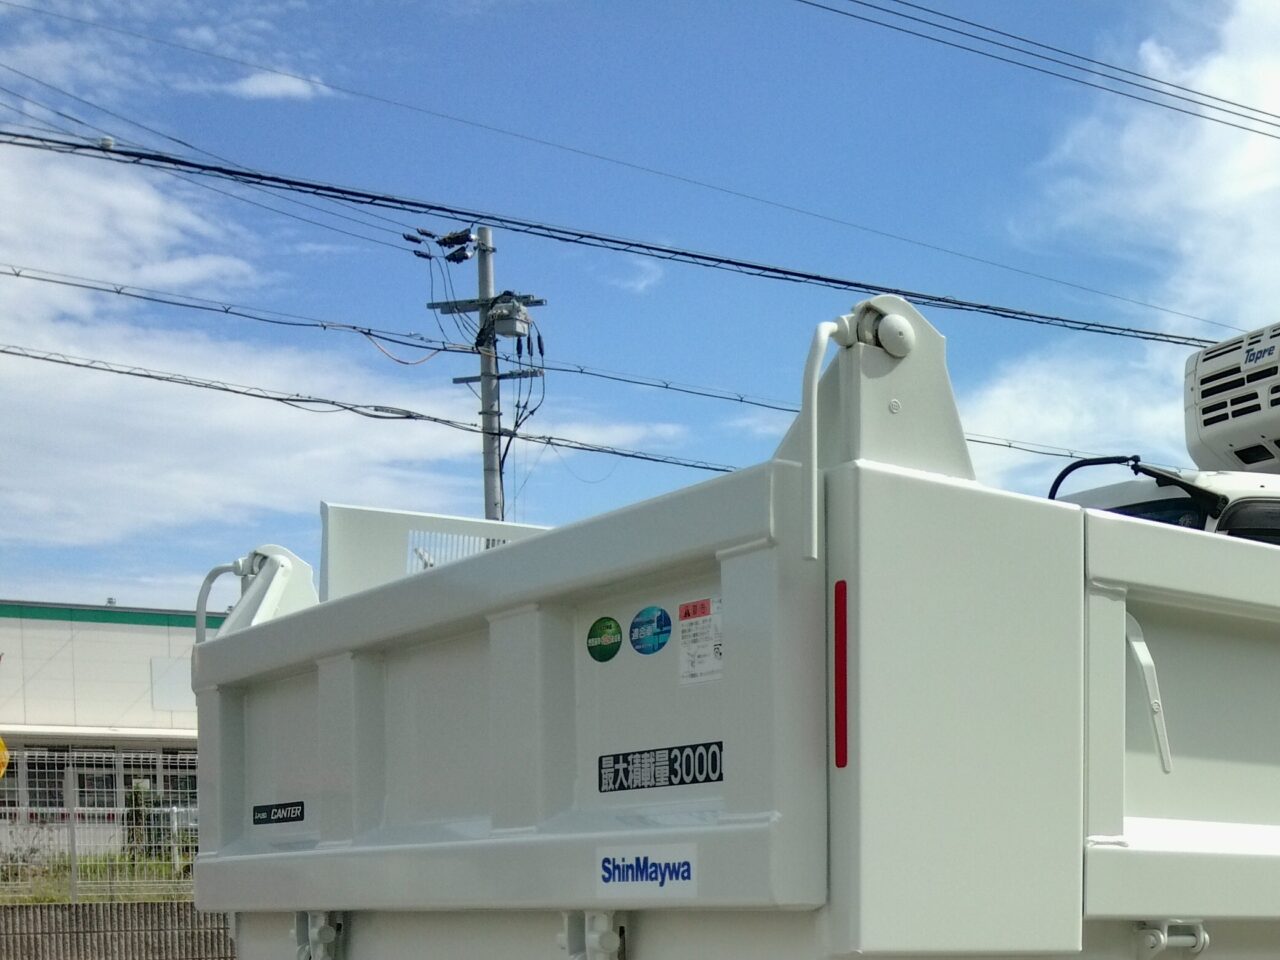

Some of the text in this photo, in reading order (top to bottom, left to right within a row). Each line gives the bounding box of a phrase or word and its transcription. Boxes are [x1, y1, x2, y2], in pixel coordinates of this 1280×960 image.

[1245, 345, 1276, 364] Topre
[601, 744, 723, 792] 最大積載量3000
[270, 806, 302, 820] CANTER
[601, 856, 692, 887] ShinMaywa
